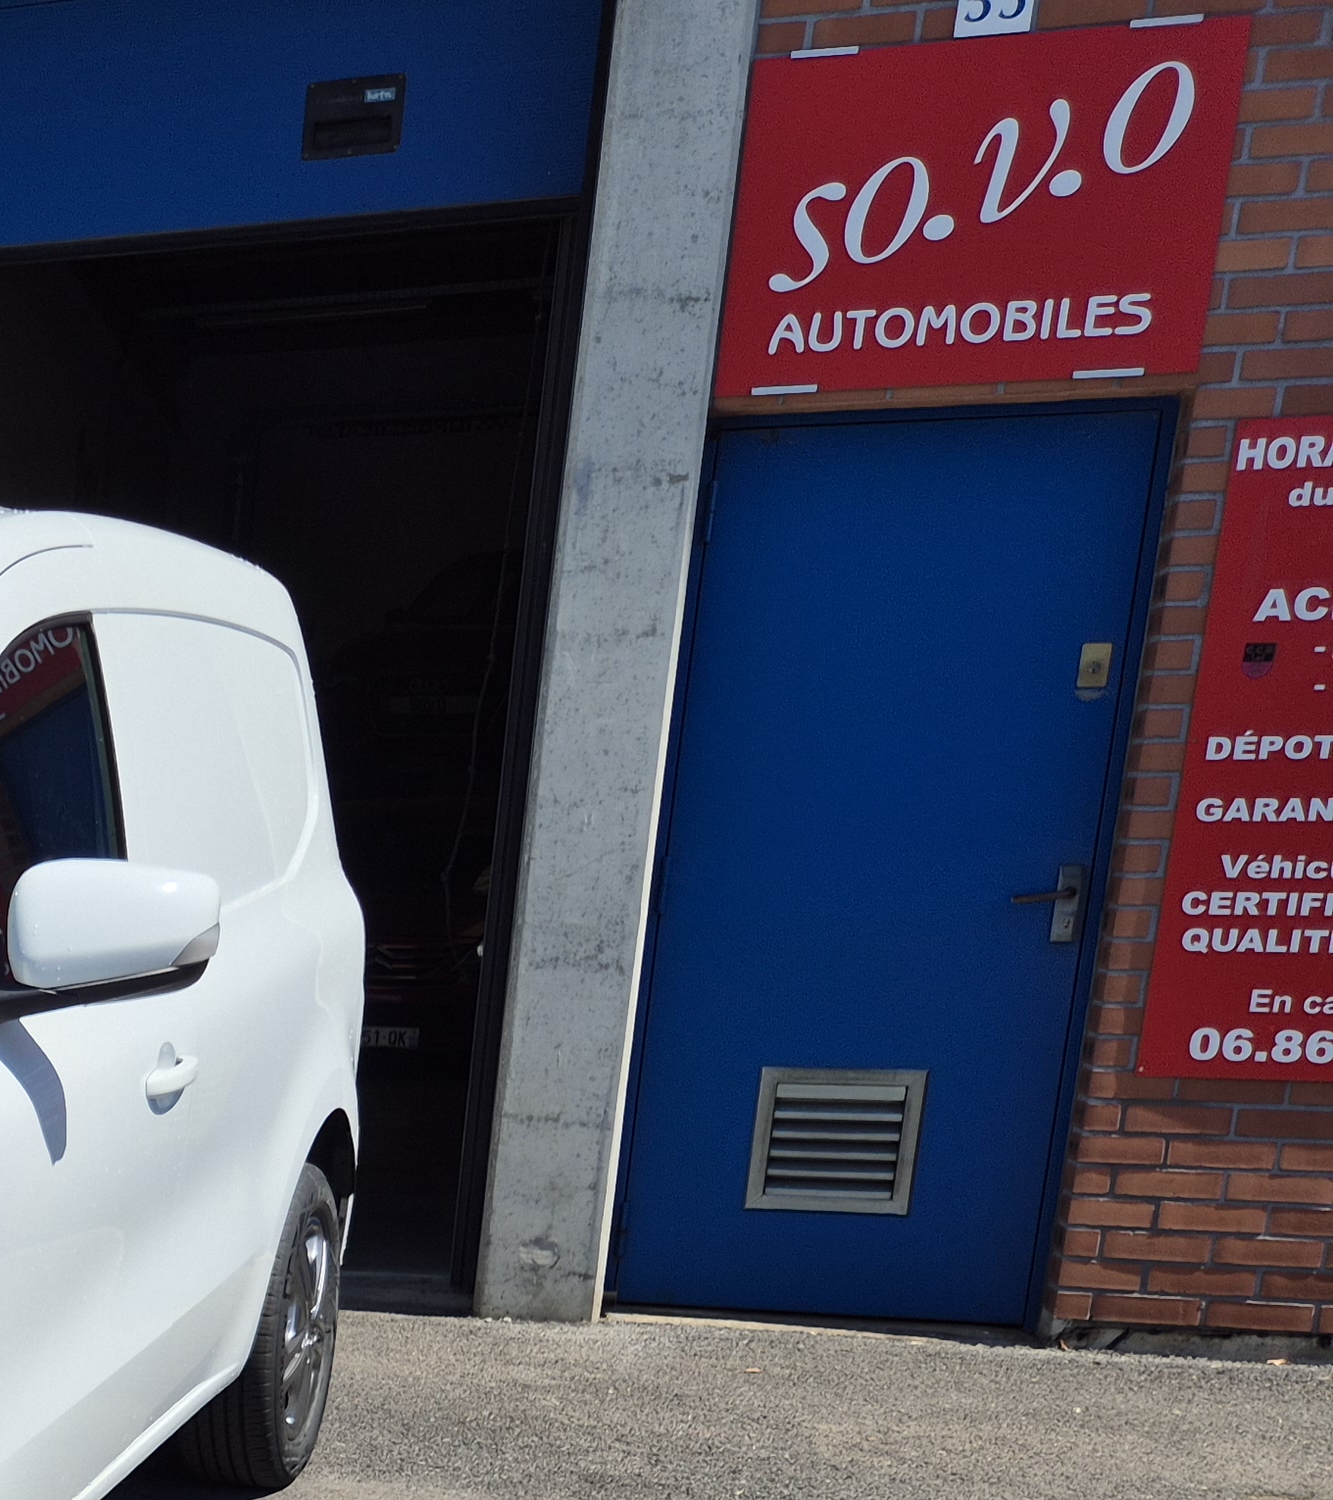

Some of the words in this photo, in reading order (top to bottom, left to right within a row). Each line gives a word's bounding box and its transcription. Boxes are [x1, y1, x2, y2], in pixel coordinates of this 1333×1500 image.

[768, 293, 1151, 355] AUTOMOBILES
[1288, 481, 1333, 507] du
[1253, 587, 1333, 622] AC
[1205, 729, 1333, 761] DÉPOT
[1196, 797, 1333, 823] GARAN
[1221, 854, 1333, 879] Véhic
[1249, 989, 1292, 1014] En
[1189, 1027, 1333, 1065] 06.86
